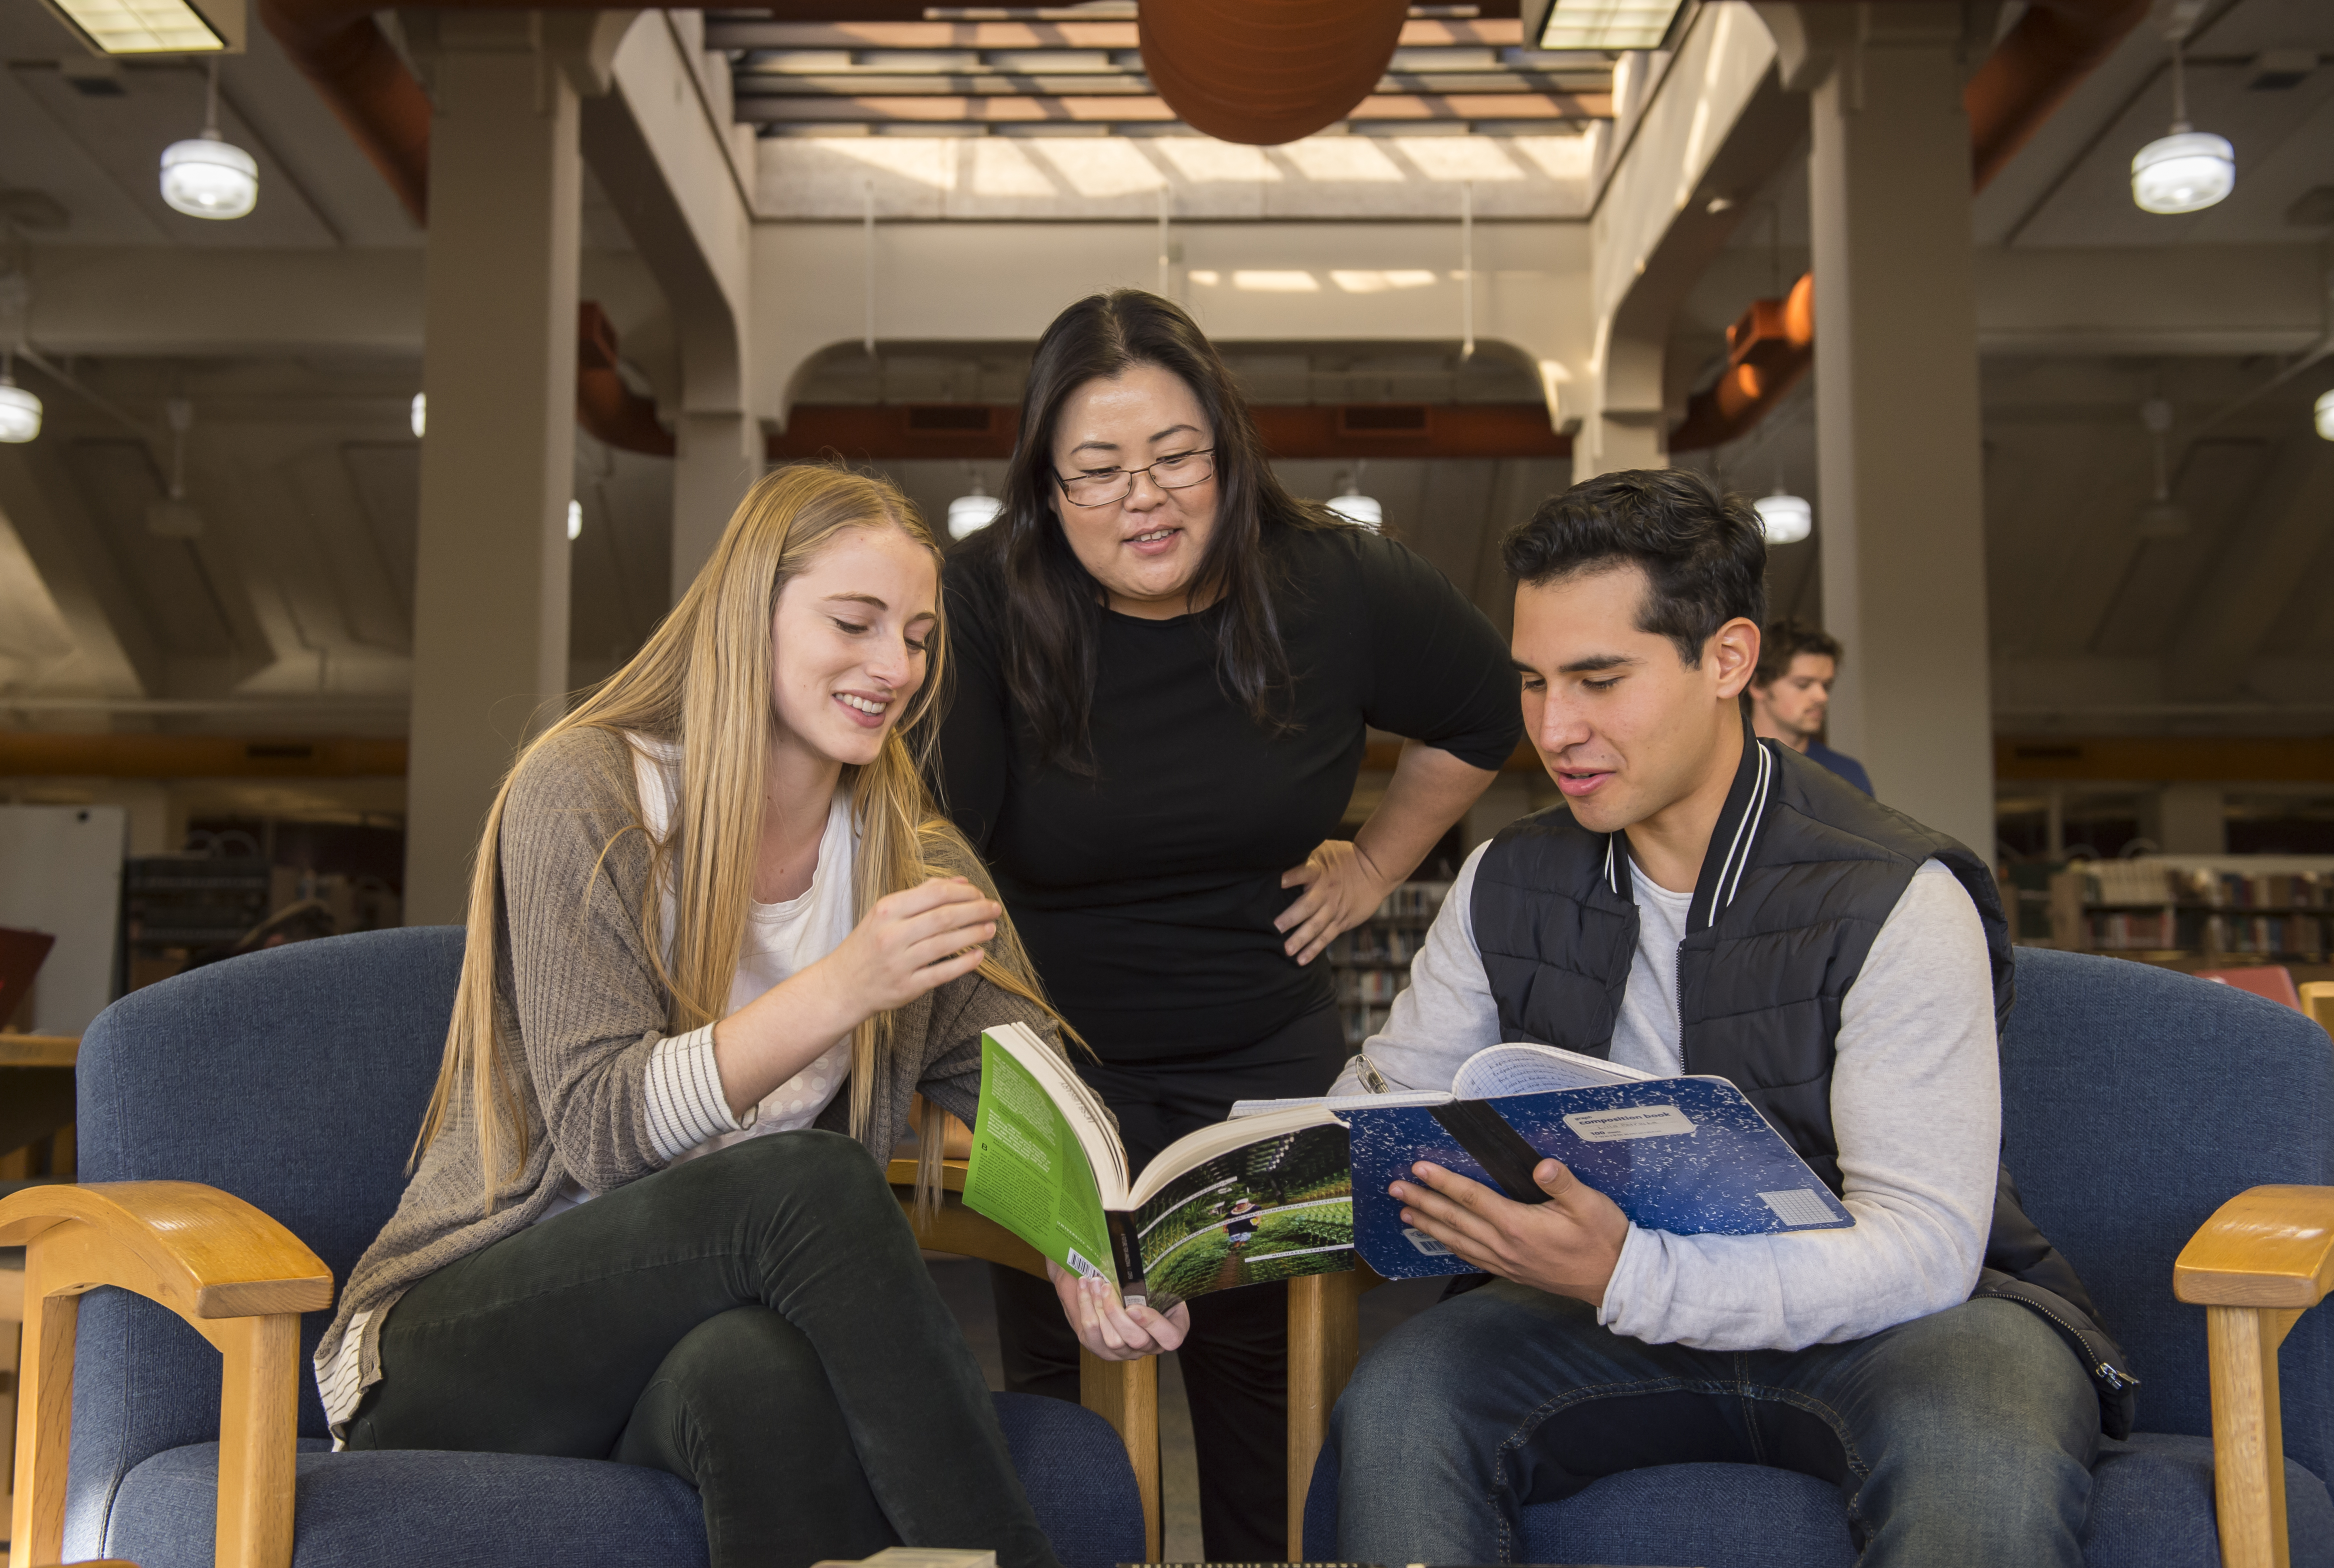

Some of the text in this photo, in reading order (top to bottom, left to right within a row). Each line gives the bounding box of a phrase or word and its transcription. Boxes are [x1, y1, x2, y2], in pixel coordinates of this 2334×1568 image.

[1580, 1116, 1642, 1125] composition
[1192, 1180, 1228, 1198] AMAZONIA
[1056, 1220, 1085, 1244] UNIVERSITY
[1173, 1231, 1200, 1248] BORMAN
[1245, 1204, 1304, 1218] ENVIRONMENTAL
